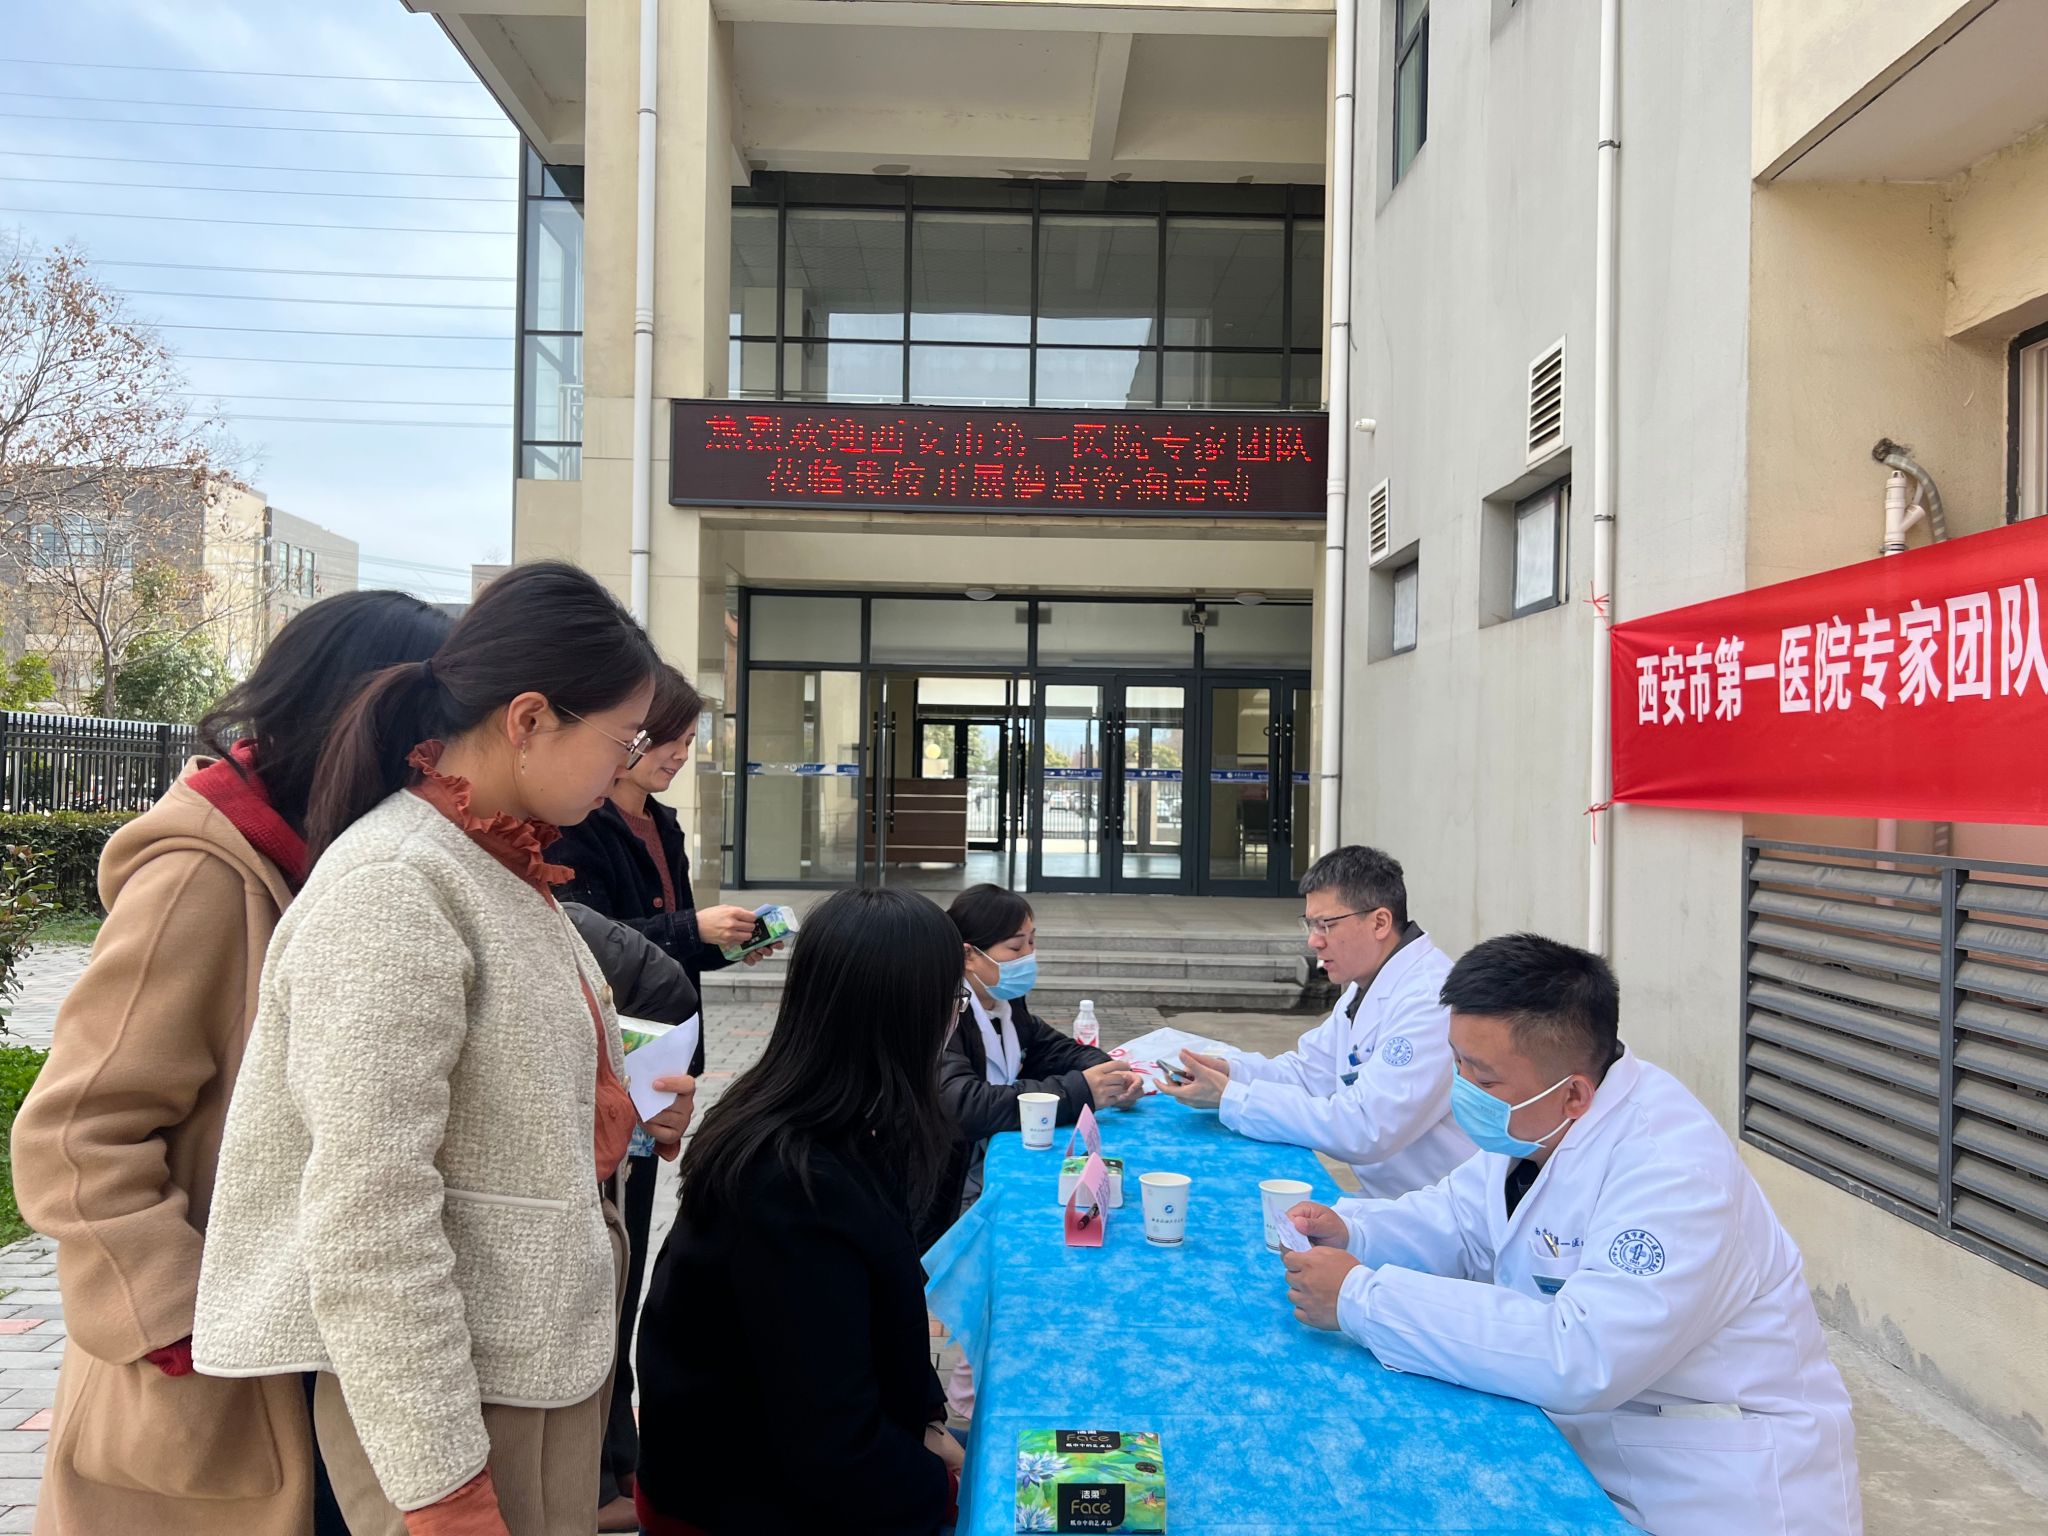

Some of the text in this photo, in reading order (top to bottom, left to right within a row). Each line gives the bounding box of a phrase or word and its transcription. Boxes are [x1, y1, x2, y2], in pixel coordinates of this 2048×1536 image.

[705, 416, 1312, 461] 热烈欢迎西安市第一医院专家团队
[1637, 577, 2048, 726] 西安市第一医院专家团队
[1066, 1434, 1110, 1442] Face
[1071, 1500, 1111, 1515] Face
